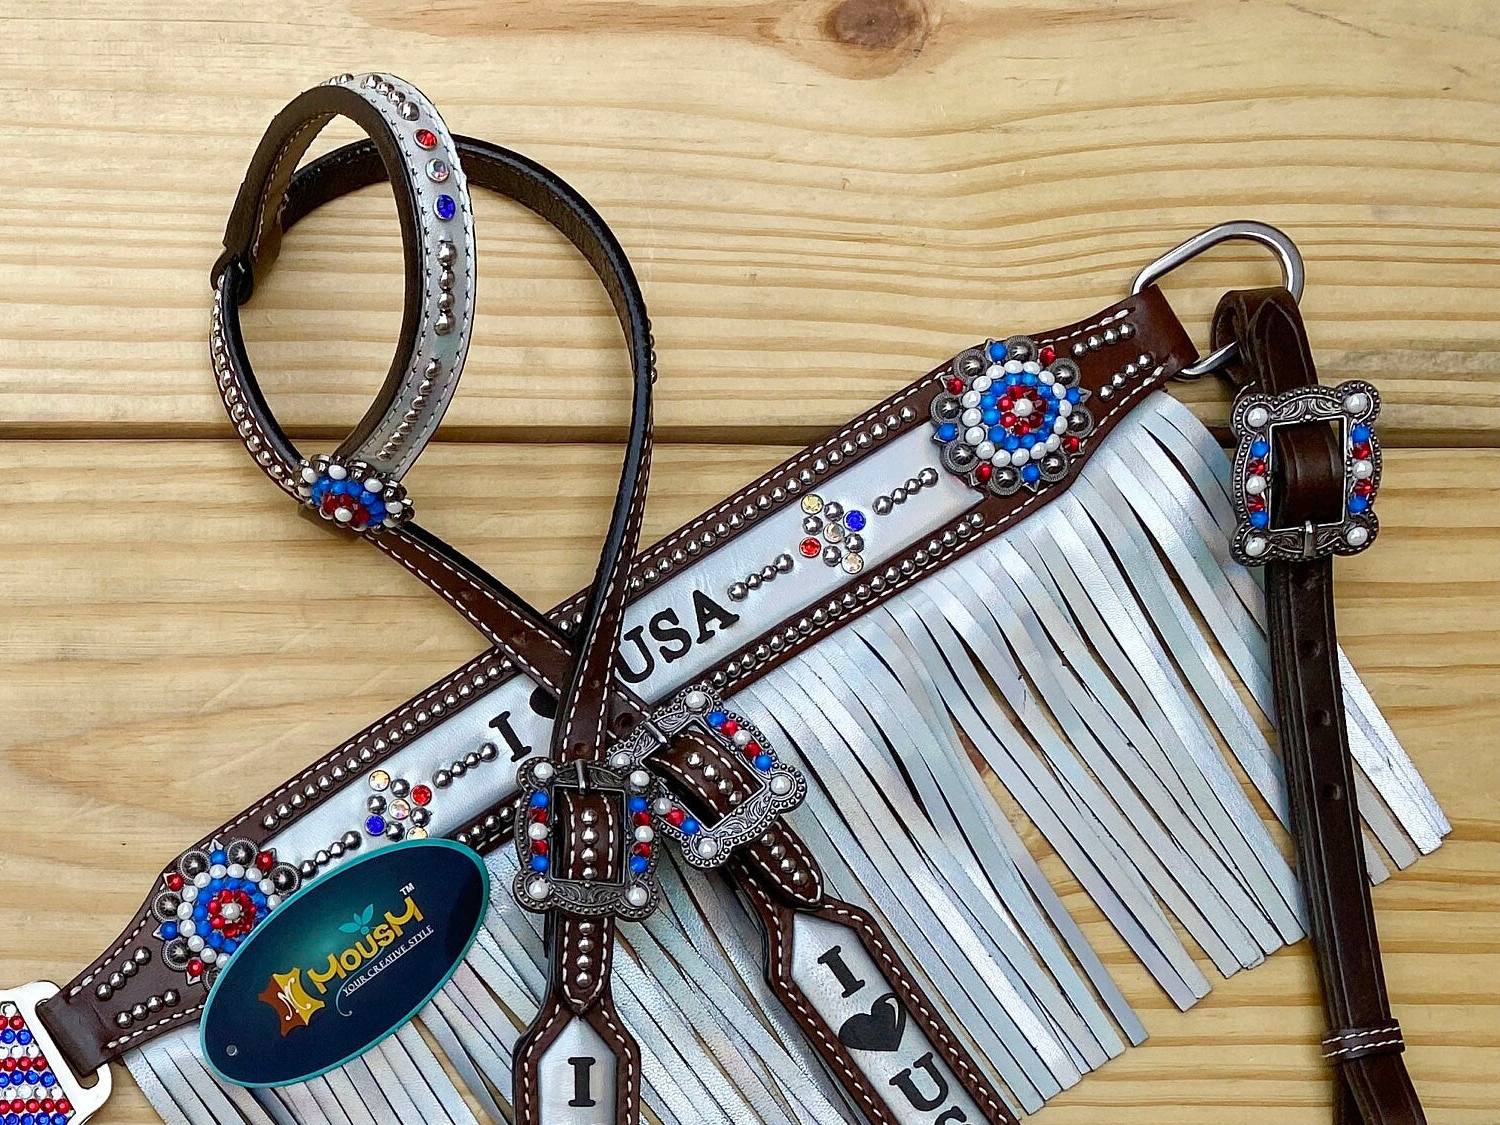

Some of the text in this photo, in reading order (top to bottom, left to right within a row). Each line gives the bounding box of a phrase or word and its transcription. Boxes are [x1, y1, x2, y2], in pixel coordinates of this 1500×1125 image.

[489, 589, 739, 762] I USA
[342, 925, 434, 997] YOUR CREATIVE STYLE
[817, 945, 866, 998] I
[567, 1057, 596, 1107] I
